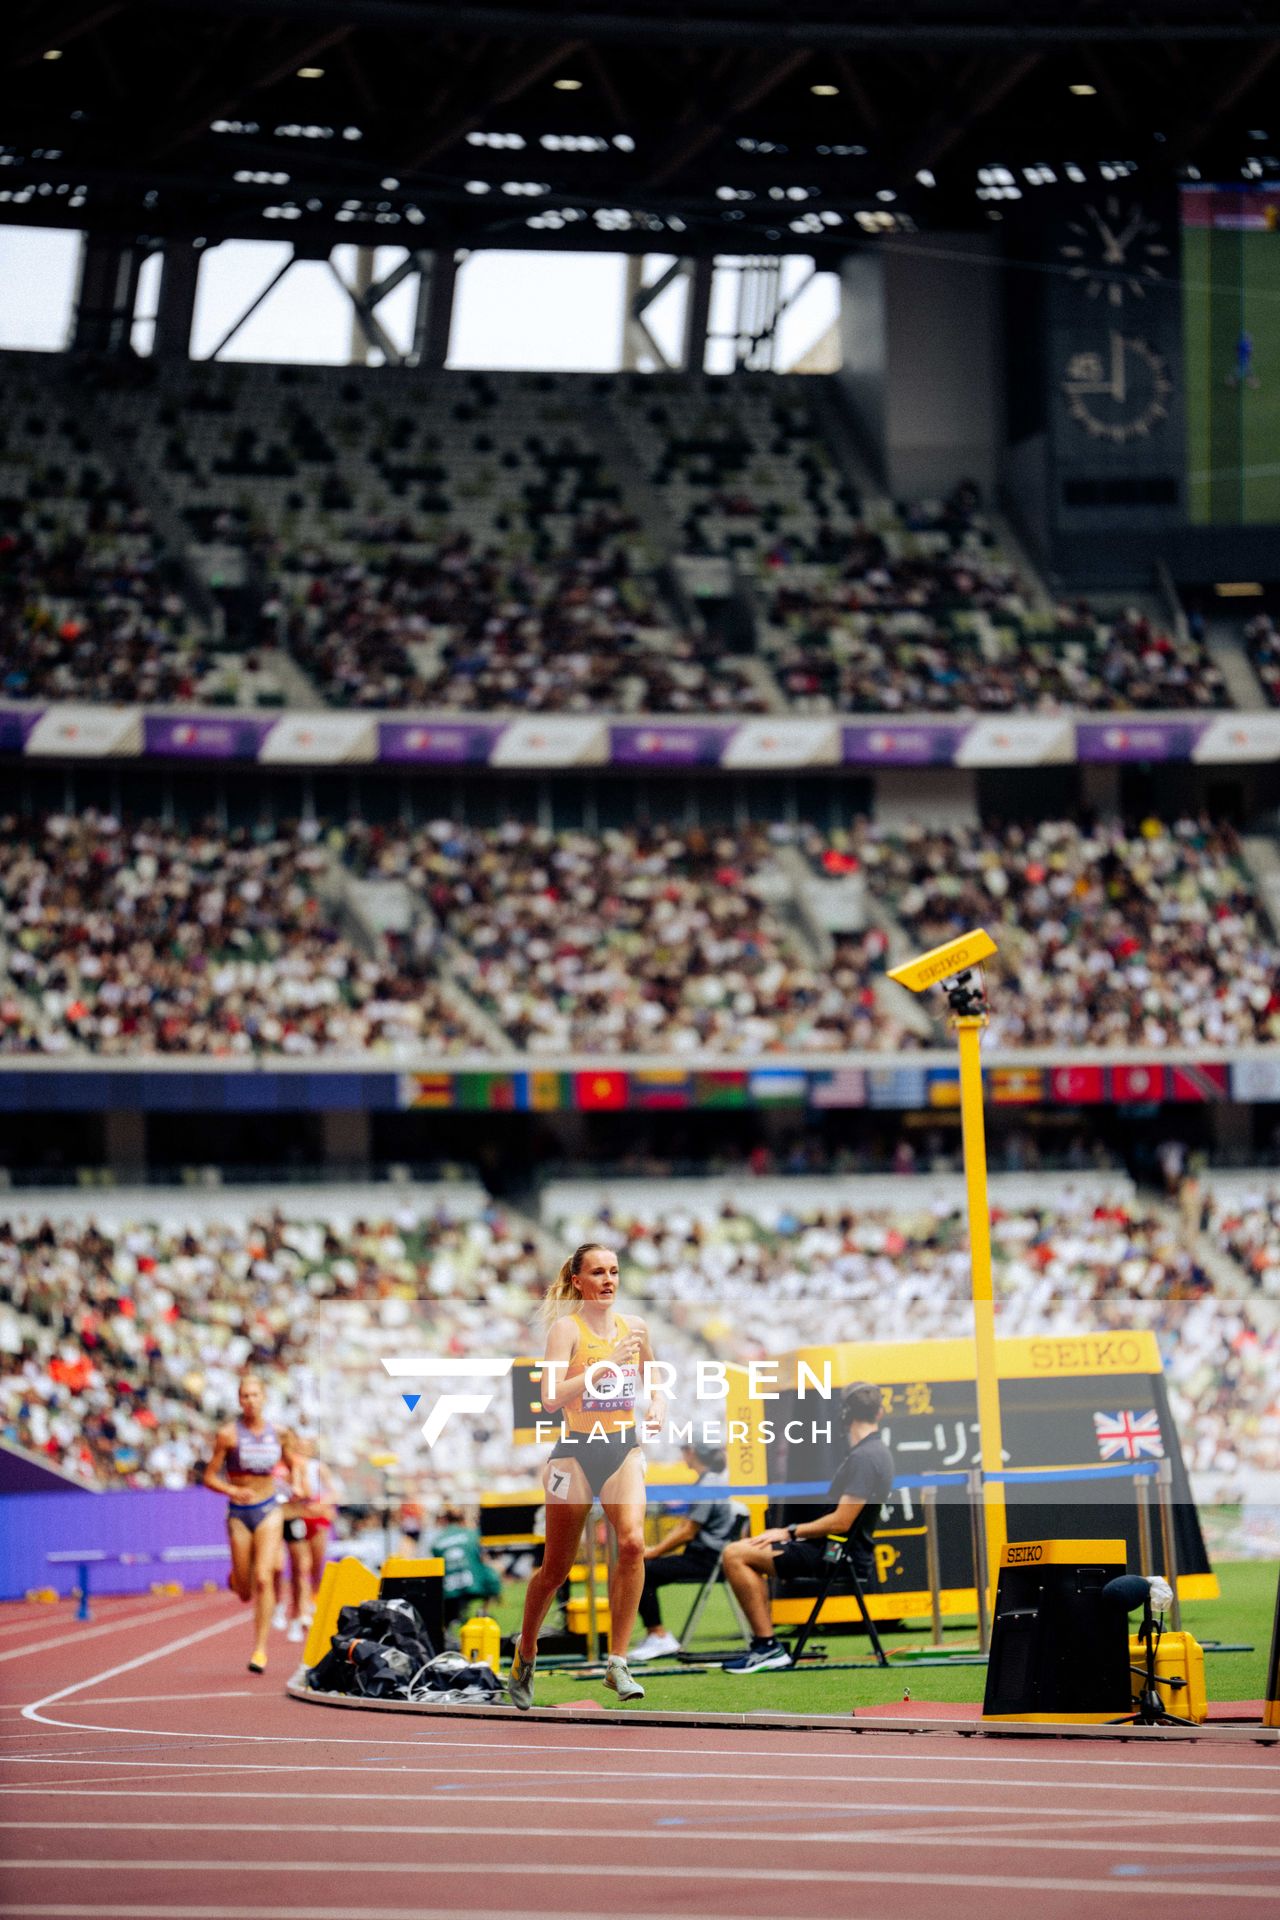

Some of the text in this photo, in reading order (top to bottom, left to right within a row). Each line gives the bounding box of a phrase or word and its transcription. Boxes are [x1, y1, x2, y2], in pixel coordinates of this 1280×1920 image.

[917, 949, 969, 983] SEIKO
[1030, 1340, 1141, 1369] SEIKO
[587, 1382, 634, 1398] MEER
[552, 1472, 565, 1492] 7
[1007, 1545, 1043, 1563] SEIKO
